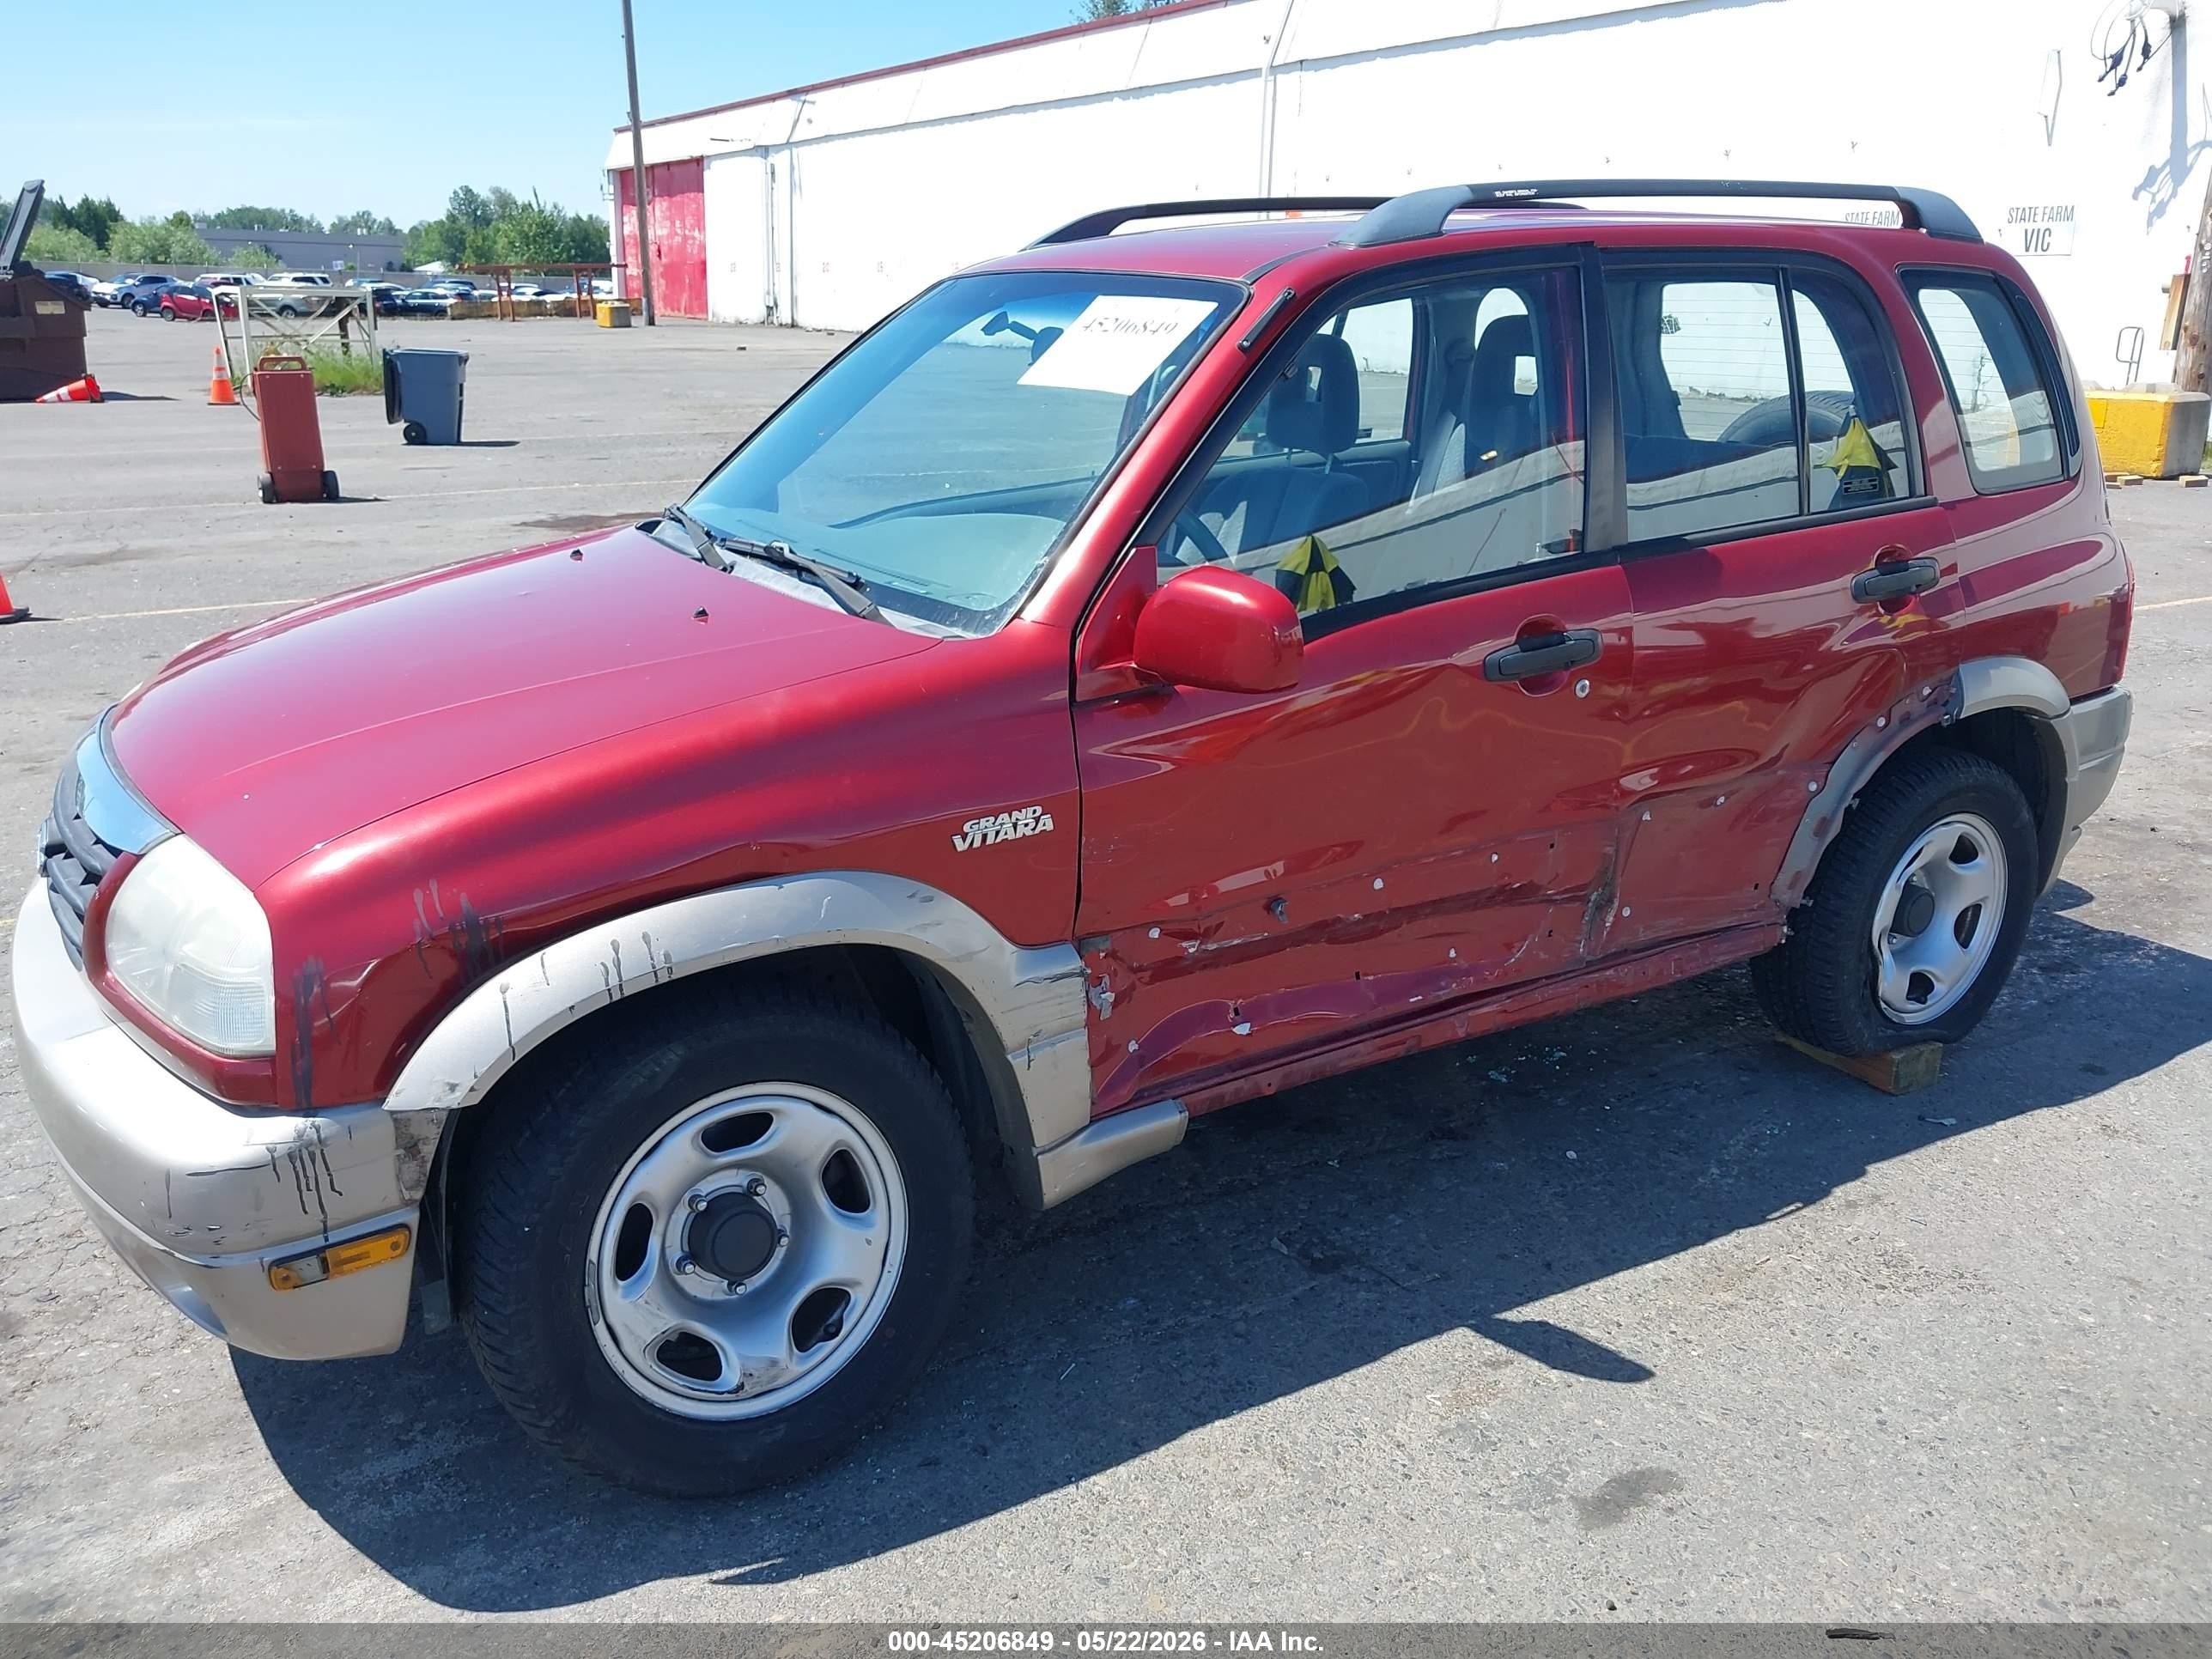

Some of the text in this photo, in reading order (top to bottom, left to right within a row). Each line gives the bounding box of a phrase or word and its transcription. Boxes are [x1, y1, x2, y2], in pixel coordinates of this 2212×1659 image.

[1872, 210, 1900, 228] FARM
[2008, 204, 2075, 224] STATE FARM
[2024, 228, 2051, 252] VIC
[963, 805, 1042, 833] GRAND
[951, 813, 1054, 853] VITARA
